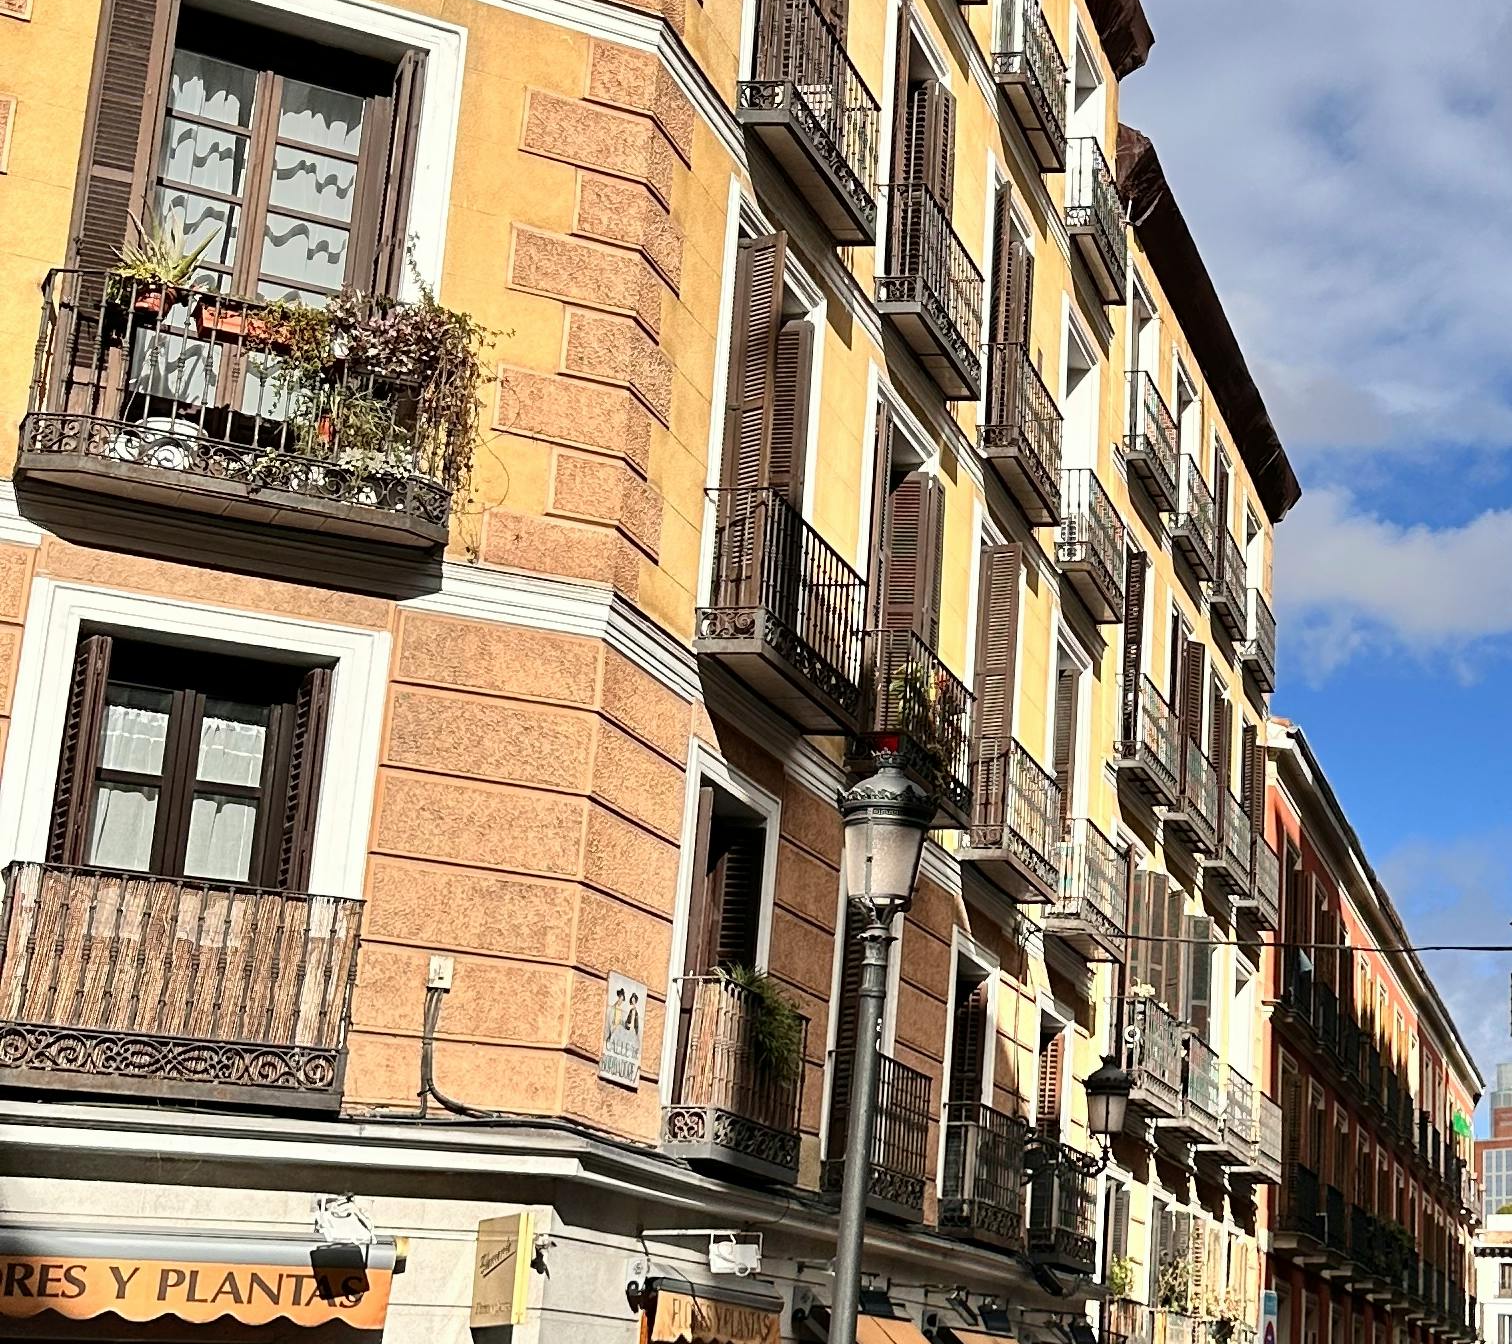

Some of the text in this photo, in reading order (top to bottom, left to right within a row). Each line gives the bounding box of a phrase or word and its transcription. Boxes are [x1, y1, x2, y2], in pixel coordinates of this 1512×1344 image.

[0, 1263, 365, 1308] RES Y PLANTAS
